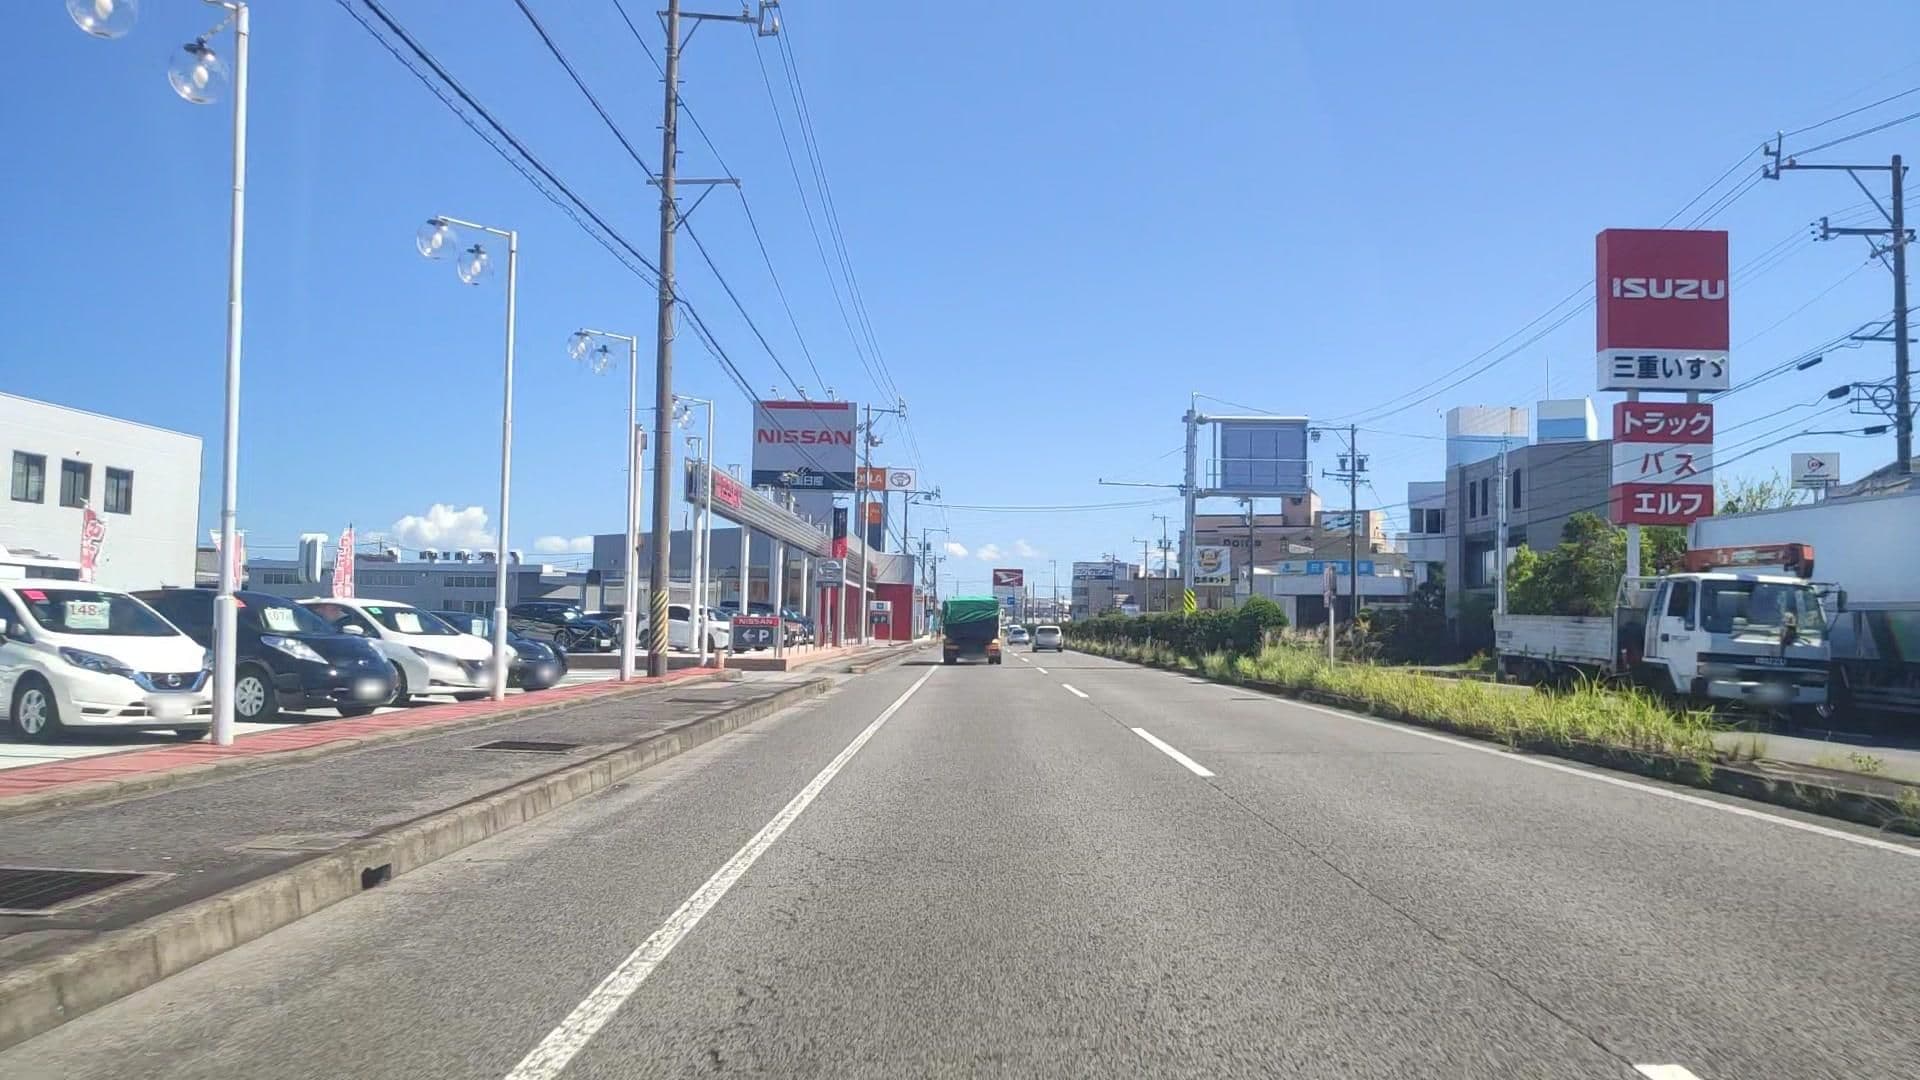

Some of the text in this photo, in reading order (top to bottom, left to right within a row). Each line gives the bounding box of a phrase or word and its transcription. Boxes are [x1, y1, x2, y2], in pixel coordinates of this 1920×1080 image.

[1612, 277, 1725, 300] ISUZU
[1623, 411, 1711, 436] トラック
[757, 429, 852, 445] NISSAN
[1640, 452, 1698, 476] バス
[1633, 492, 1703, 515] エルフ
[70, 604, 97, 616] 148
[758, 630, 769, 643] P
